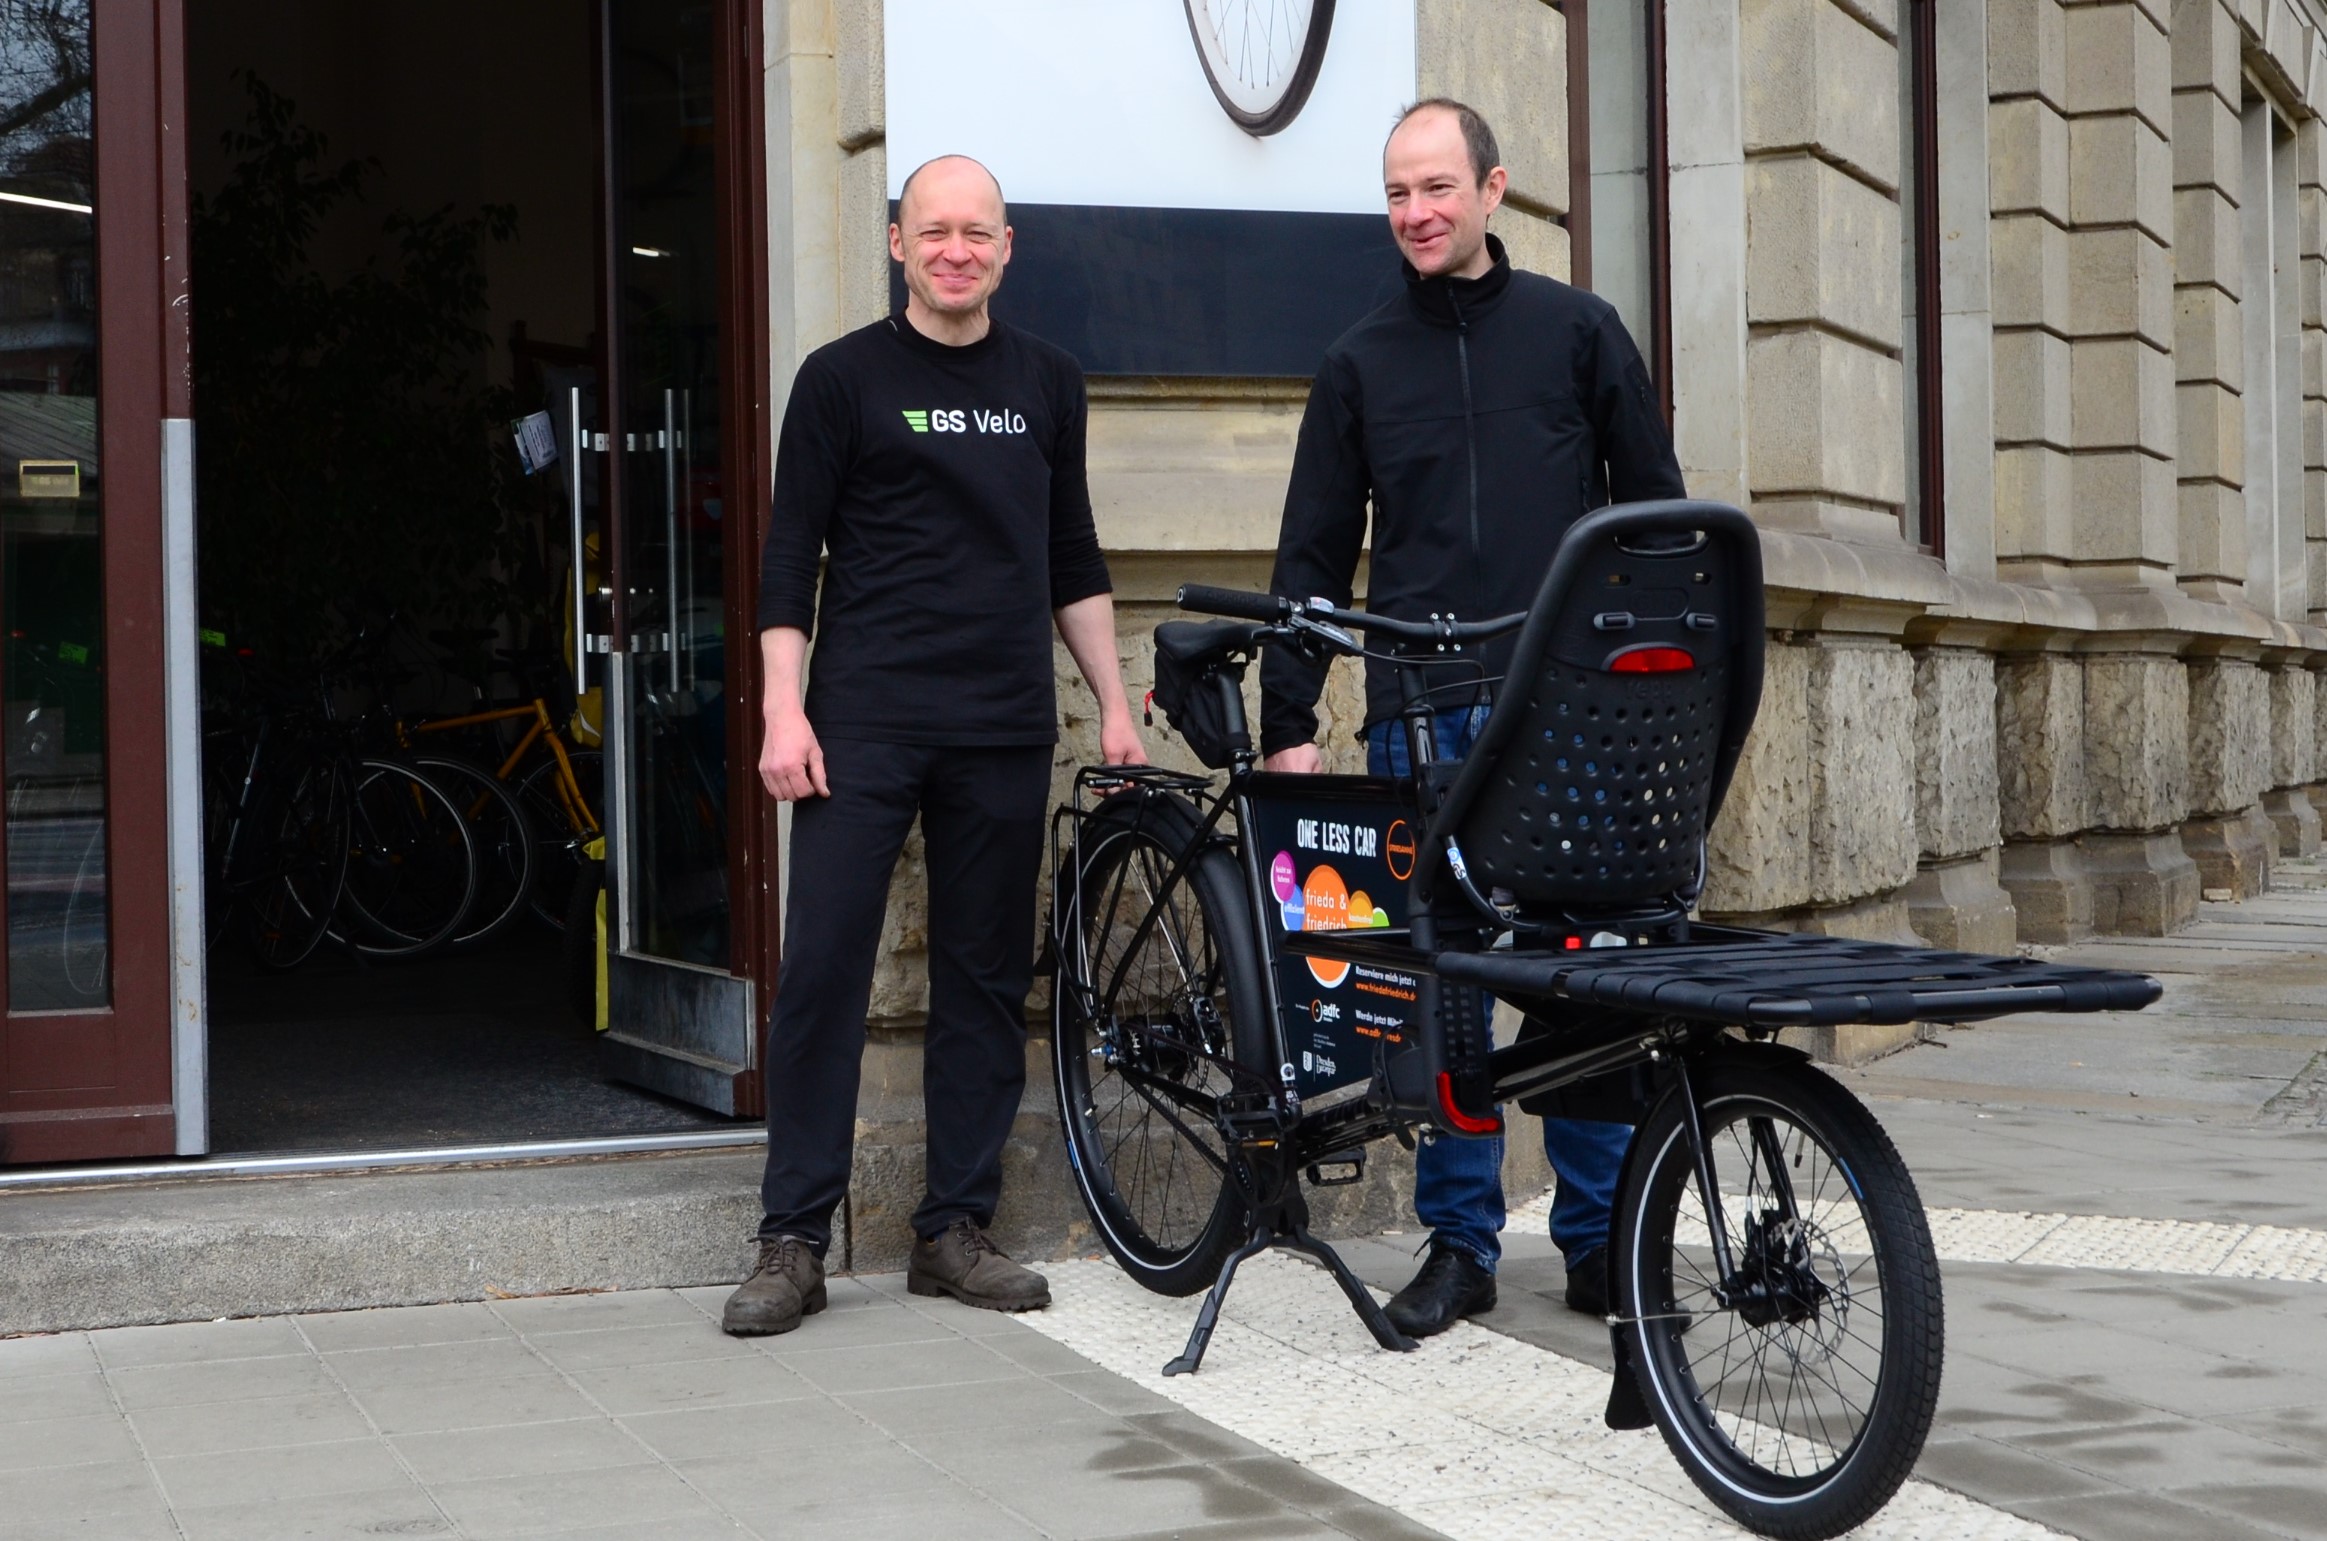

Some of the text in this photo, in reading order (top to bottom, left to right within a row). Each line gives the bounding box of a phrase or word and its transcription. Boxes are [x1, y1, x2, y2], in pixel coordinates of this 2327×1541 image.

[931, 408, 1026, 434] GS Velo
[1297, 818, 1377, 858] ONE LESS CAR
[1306, 888, 1347, 910] frieda &
[1355, 965, 1384, 980] Reserviere
[1385, 972, 1399, 983] mich
[1399, 974, 1412, 986] jetzt
[1323, 1003, 1341, 1019] adfc
[1355, 1009, 1374, 1022] Werde
[1374, 1013, 1387, 1025] jetzt
